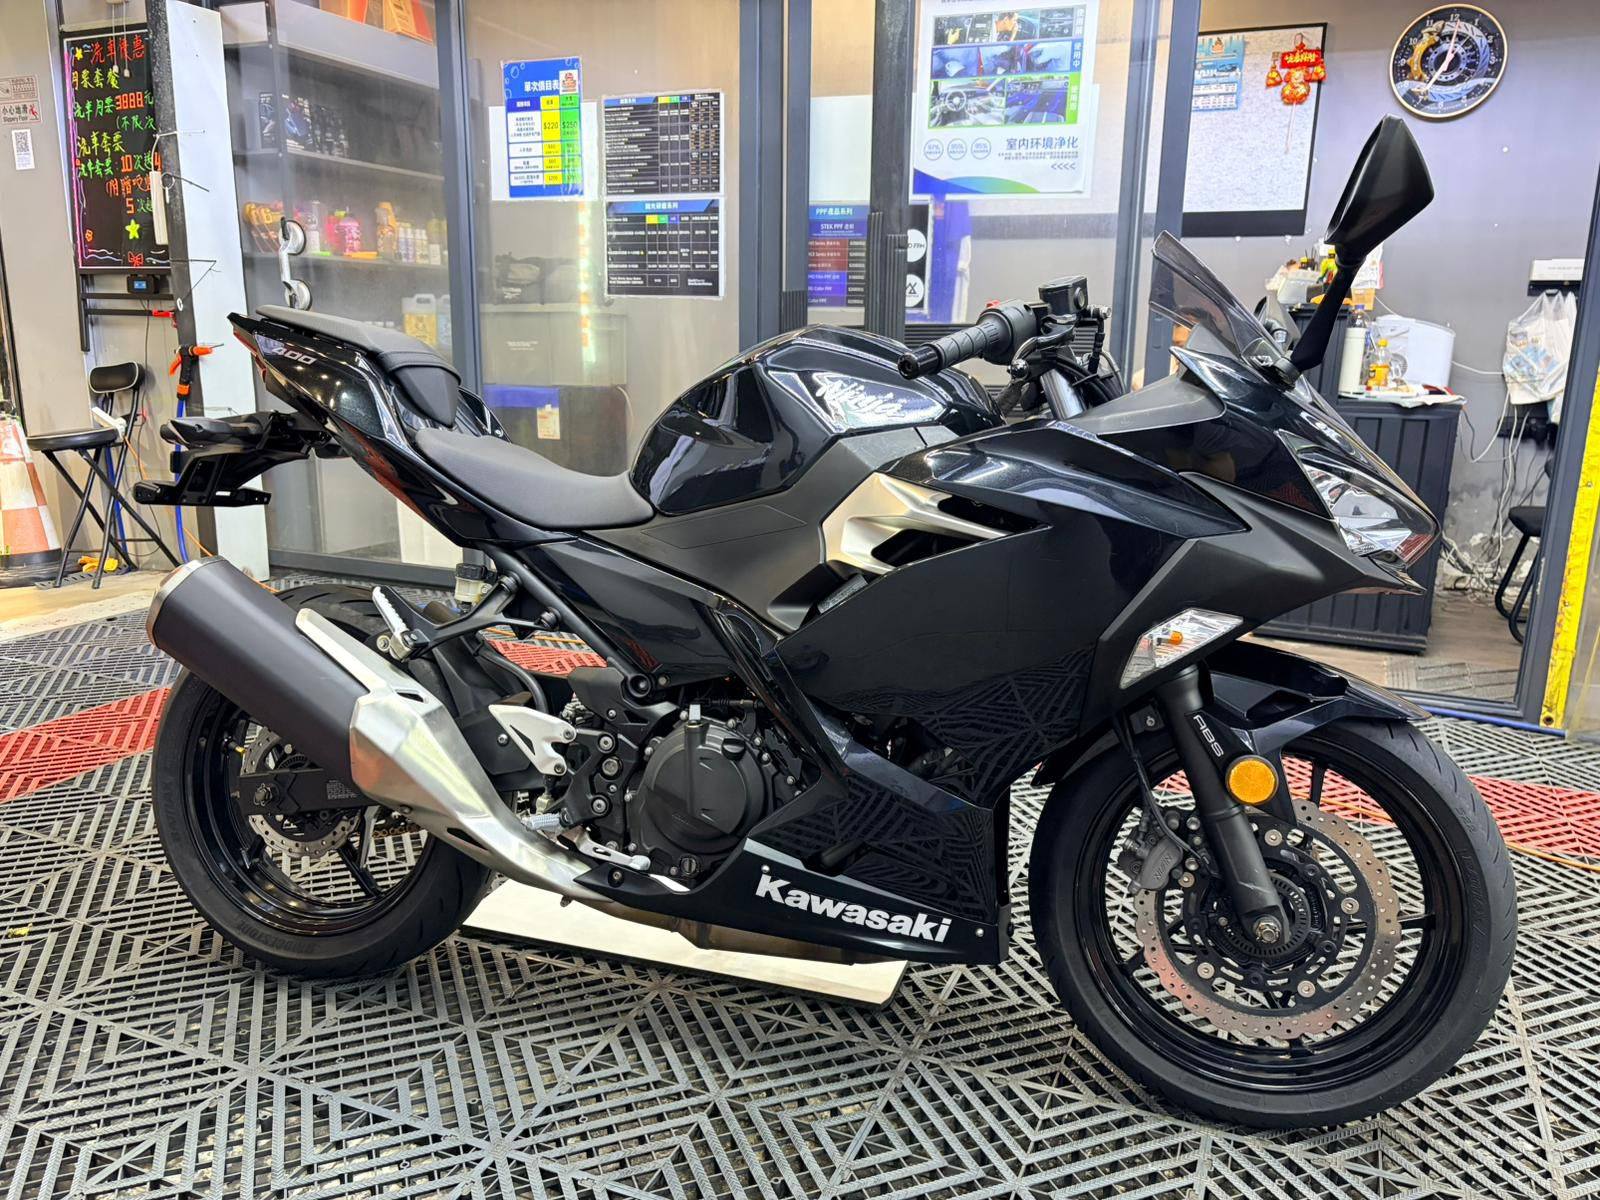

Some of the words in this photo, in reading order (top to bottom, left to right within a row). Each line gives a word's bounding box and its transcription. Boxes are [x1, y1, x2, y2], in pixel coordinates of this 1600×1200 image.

[1450, 13, 1460, 21] 12
[1409, 37, 1418, 45] 10
[543, 121, 559, 130] $220
[1006, 136, 1079, 150] 室内环境净化
[271, 346, 317, 365] 400
[1193, 714, 1224, 757] ABS
[755, 874, 952, 943] Kawasaki
